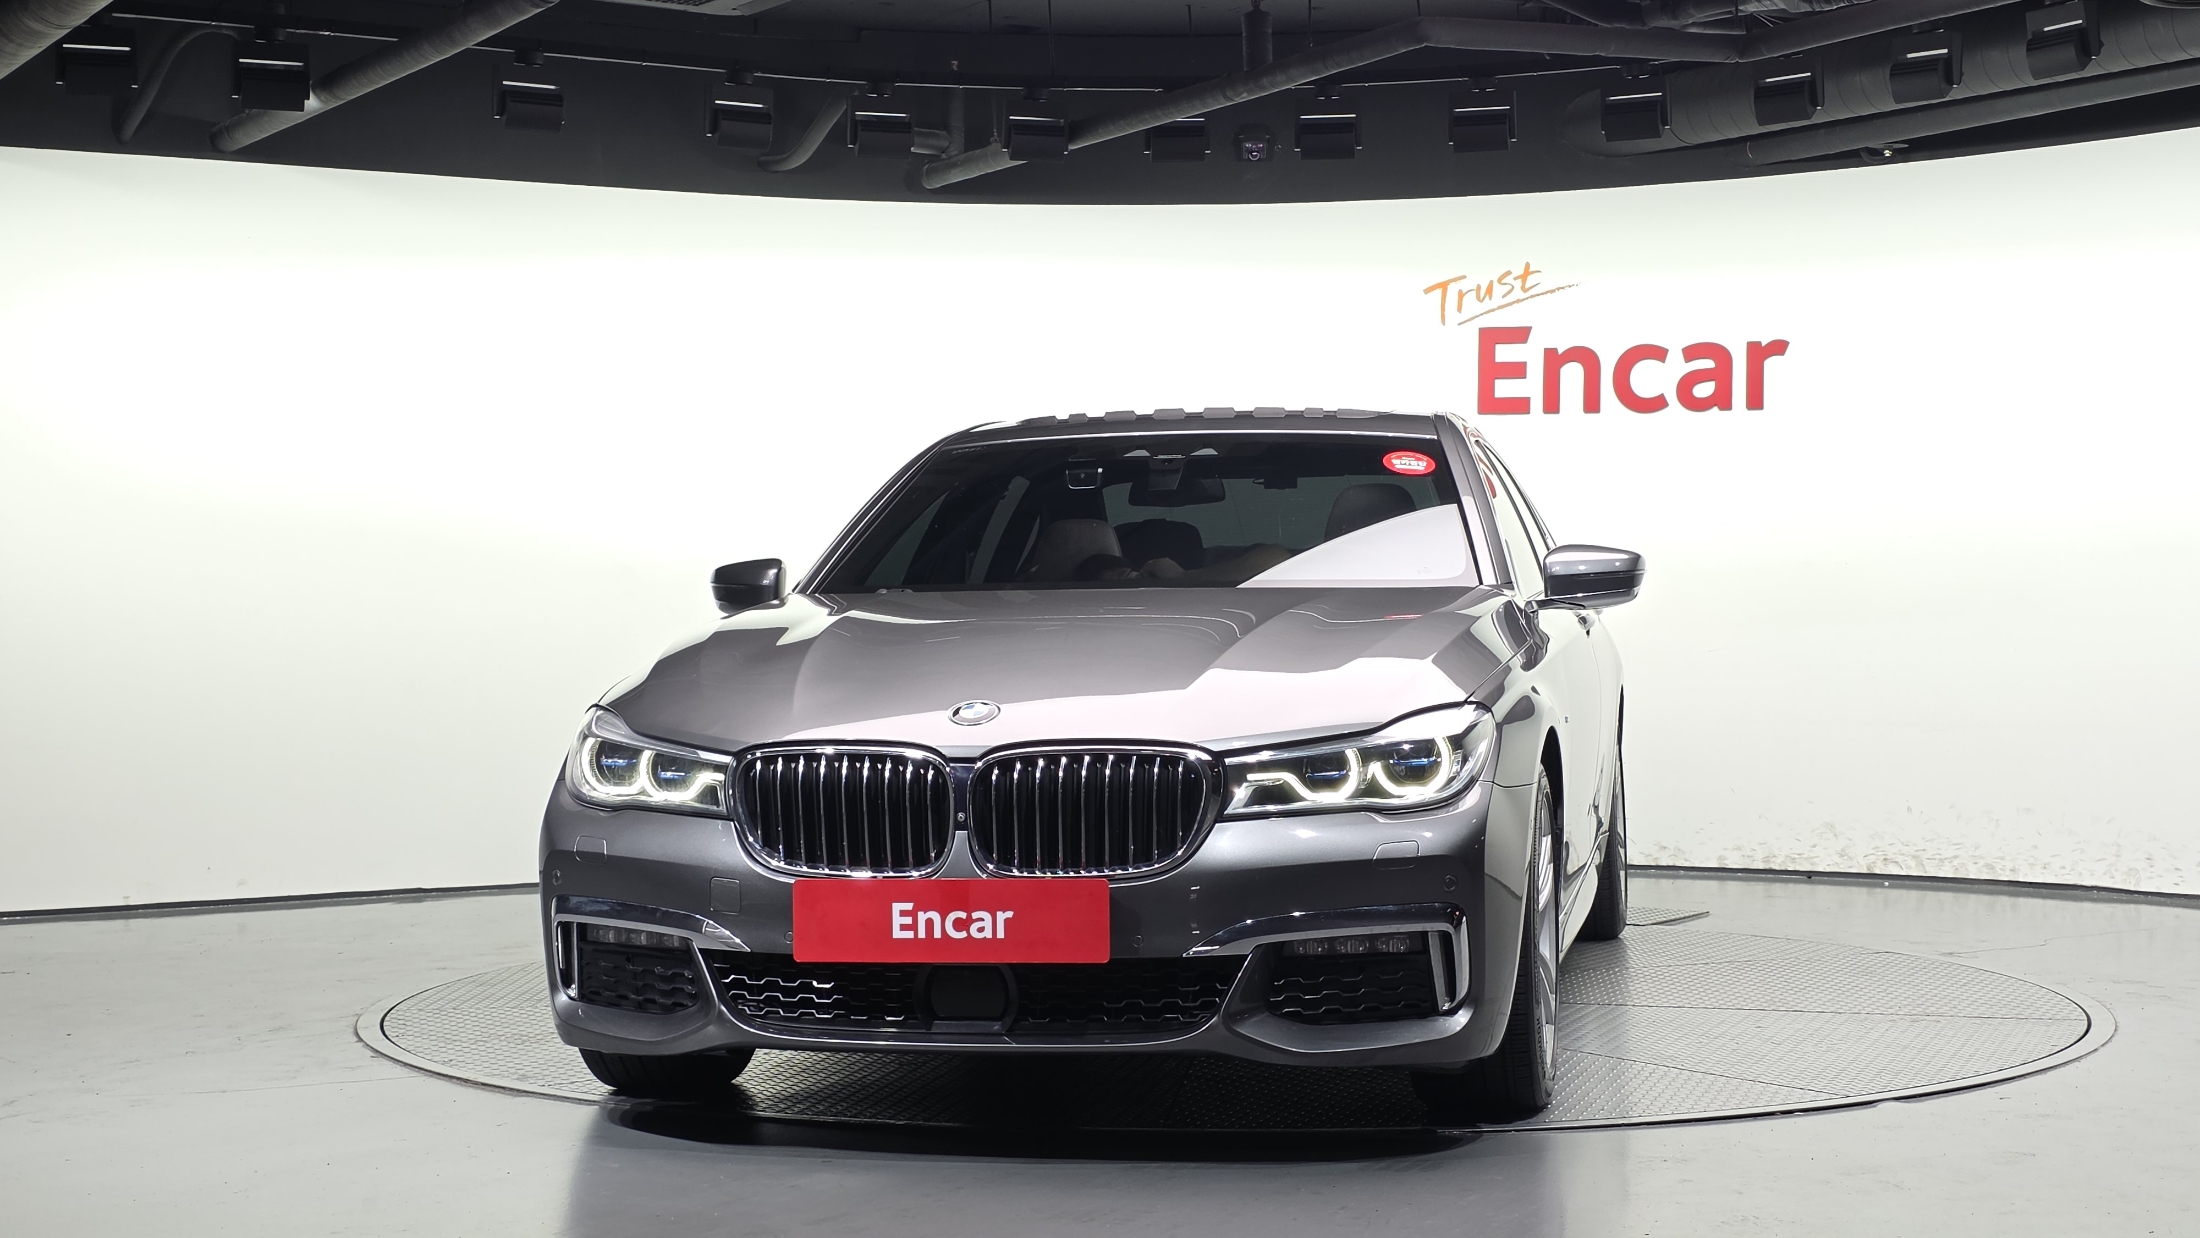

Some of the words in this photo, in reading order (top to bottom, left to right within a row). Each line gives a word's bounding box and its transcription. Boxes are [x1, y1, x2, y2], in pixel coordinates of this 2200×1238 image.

[1423, 262, 1541, 325] Trust
[1477, 326, 1789, 415] Encar
[891, 902, 1014, 939] Encar
